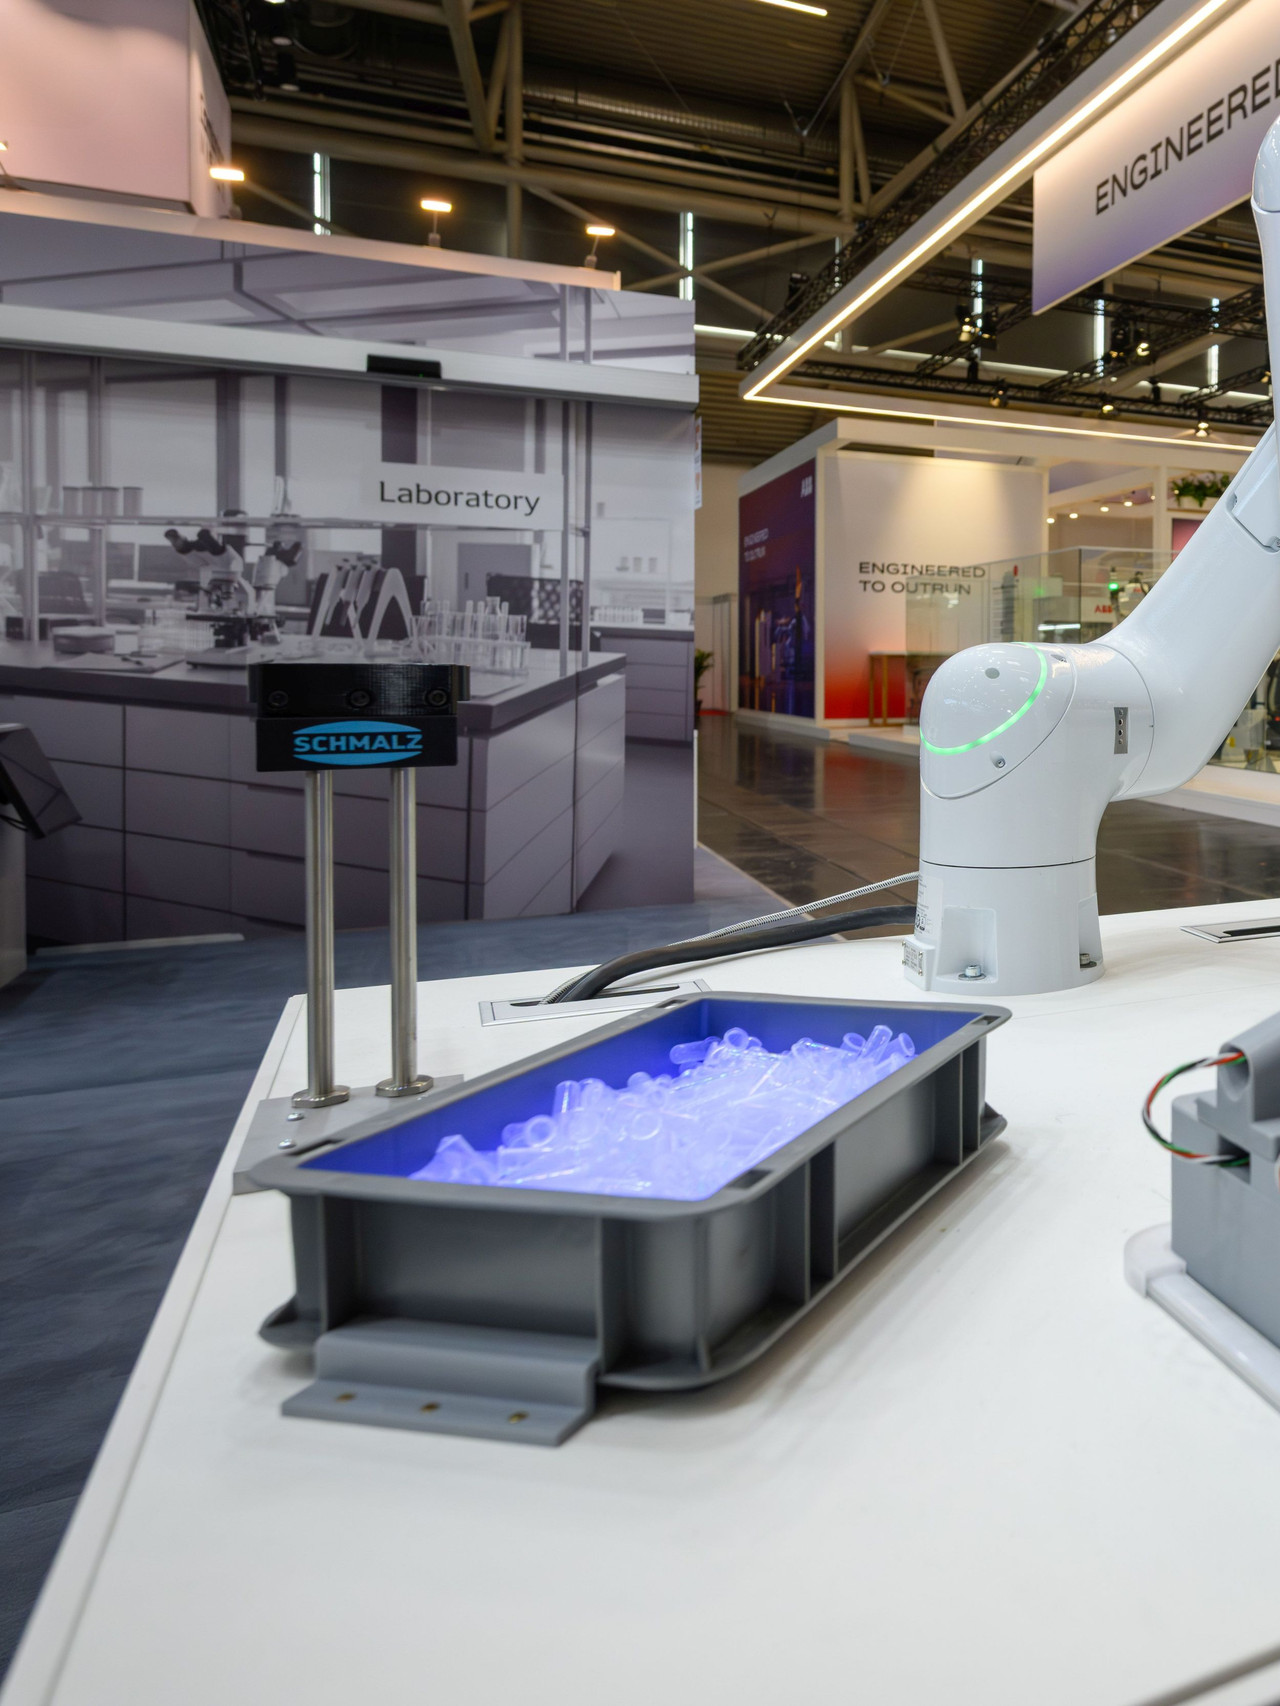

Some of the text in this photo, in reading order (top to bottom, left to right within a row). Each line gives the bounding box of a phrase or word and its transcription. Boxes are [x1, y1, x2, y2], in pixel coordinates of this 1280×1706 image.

[379, 480, 541, 517] Laboratory
[858, 562, 986, 578] ENGINEERED
[858, 580, 971, 595] TO OUTRUN
[1094, 605, 1113, 614] ABB
[293, 734, 423, 752] SCHMALZ
